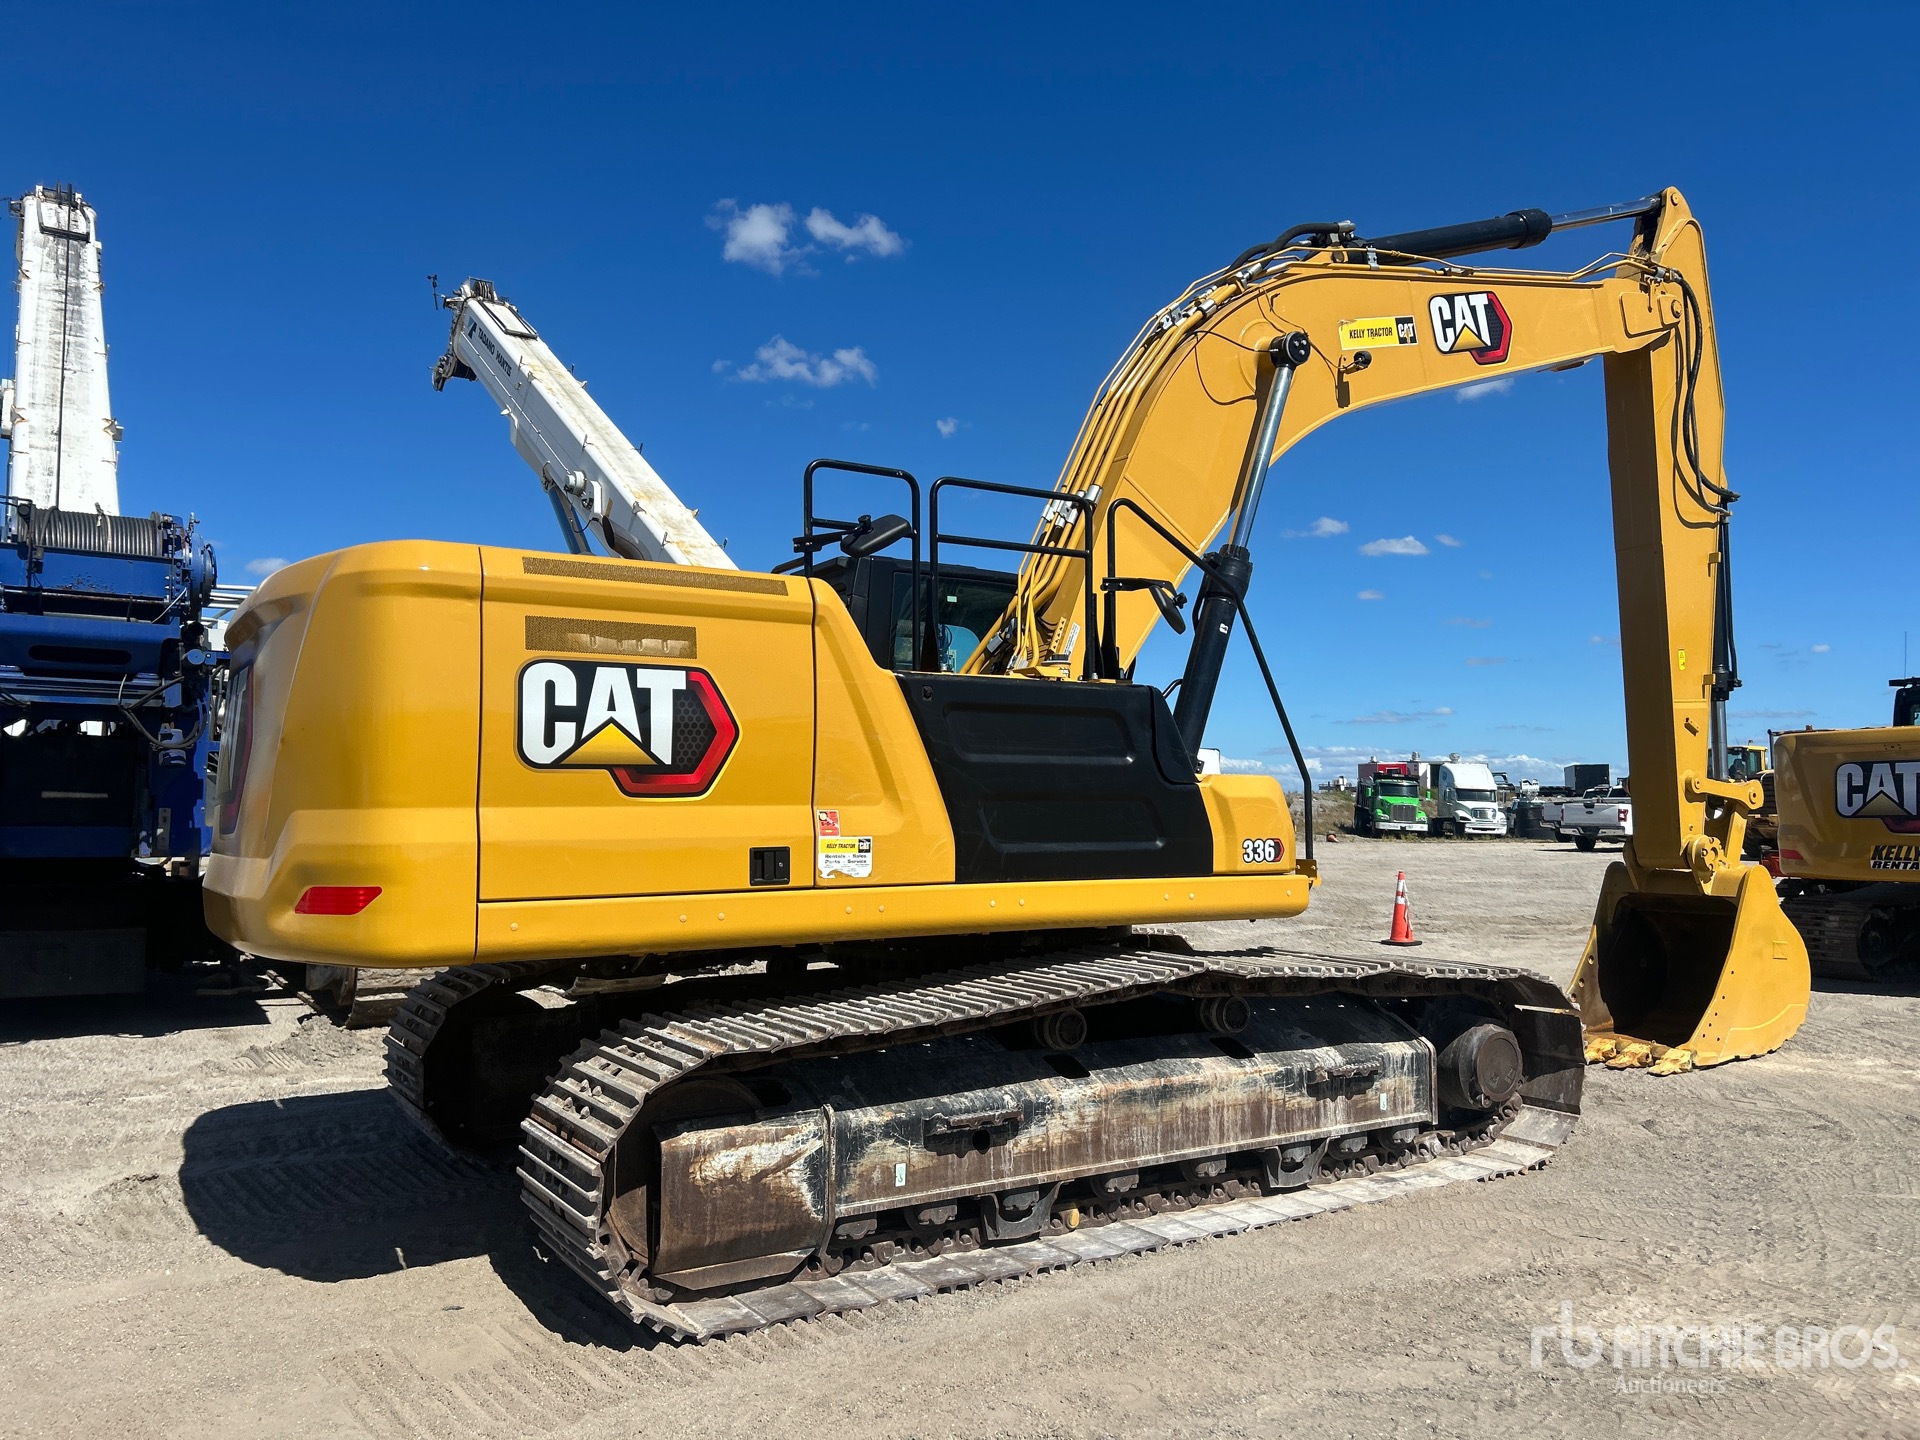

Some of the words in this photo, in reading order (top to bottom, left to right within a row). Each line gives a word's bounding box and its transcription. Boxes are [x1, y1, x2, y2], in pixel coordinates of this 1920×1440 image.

[478, 328, 495, 354] TADANO
[1349, 328, 1365, 339] KELLY
[1367, 327, 1393, 338] TRACTOR
[1429, 292, 1493, 352] CAT
[522, 661, 687, 766] CAT
[1836, 763, 1920, 816] CAT
[1243, 839, 1275, 862] 336
